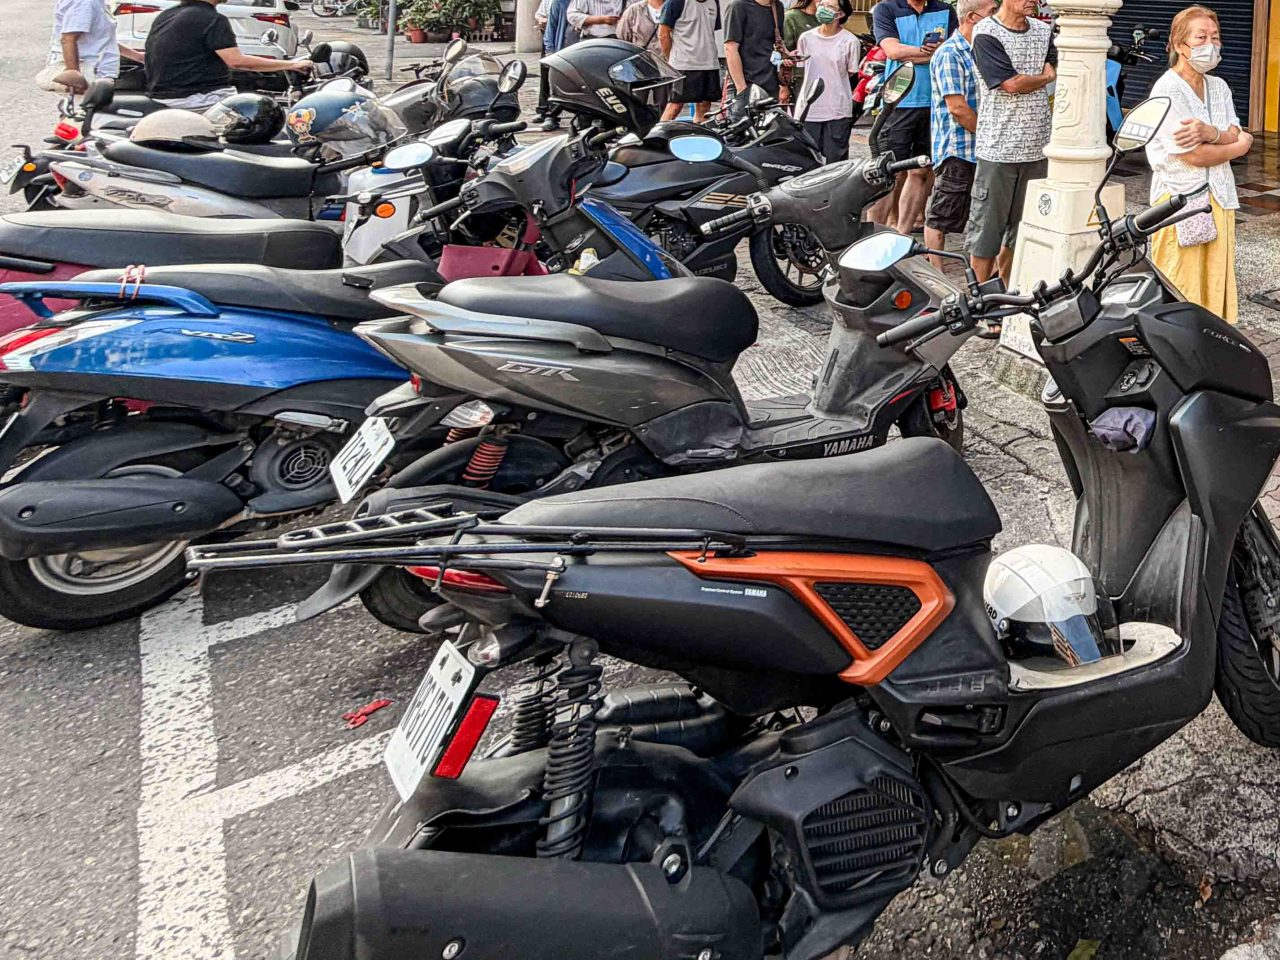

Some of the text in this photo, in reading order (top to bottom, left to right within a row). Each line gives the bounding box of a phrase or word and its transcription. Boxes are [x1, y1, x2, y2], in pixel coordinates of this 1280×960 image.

[598, 87, 628, 114] EVO
[823, 434, 874, 456] YAMAHA
[745, 588, 767, 598] YAMAHA
